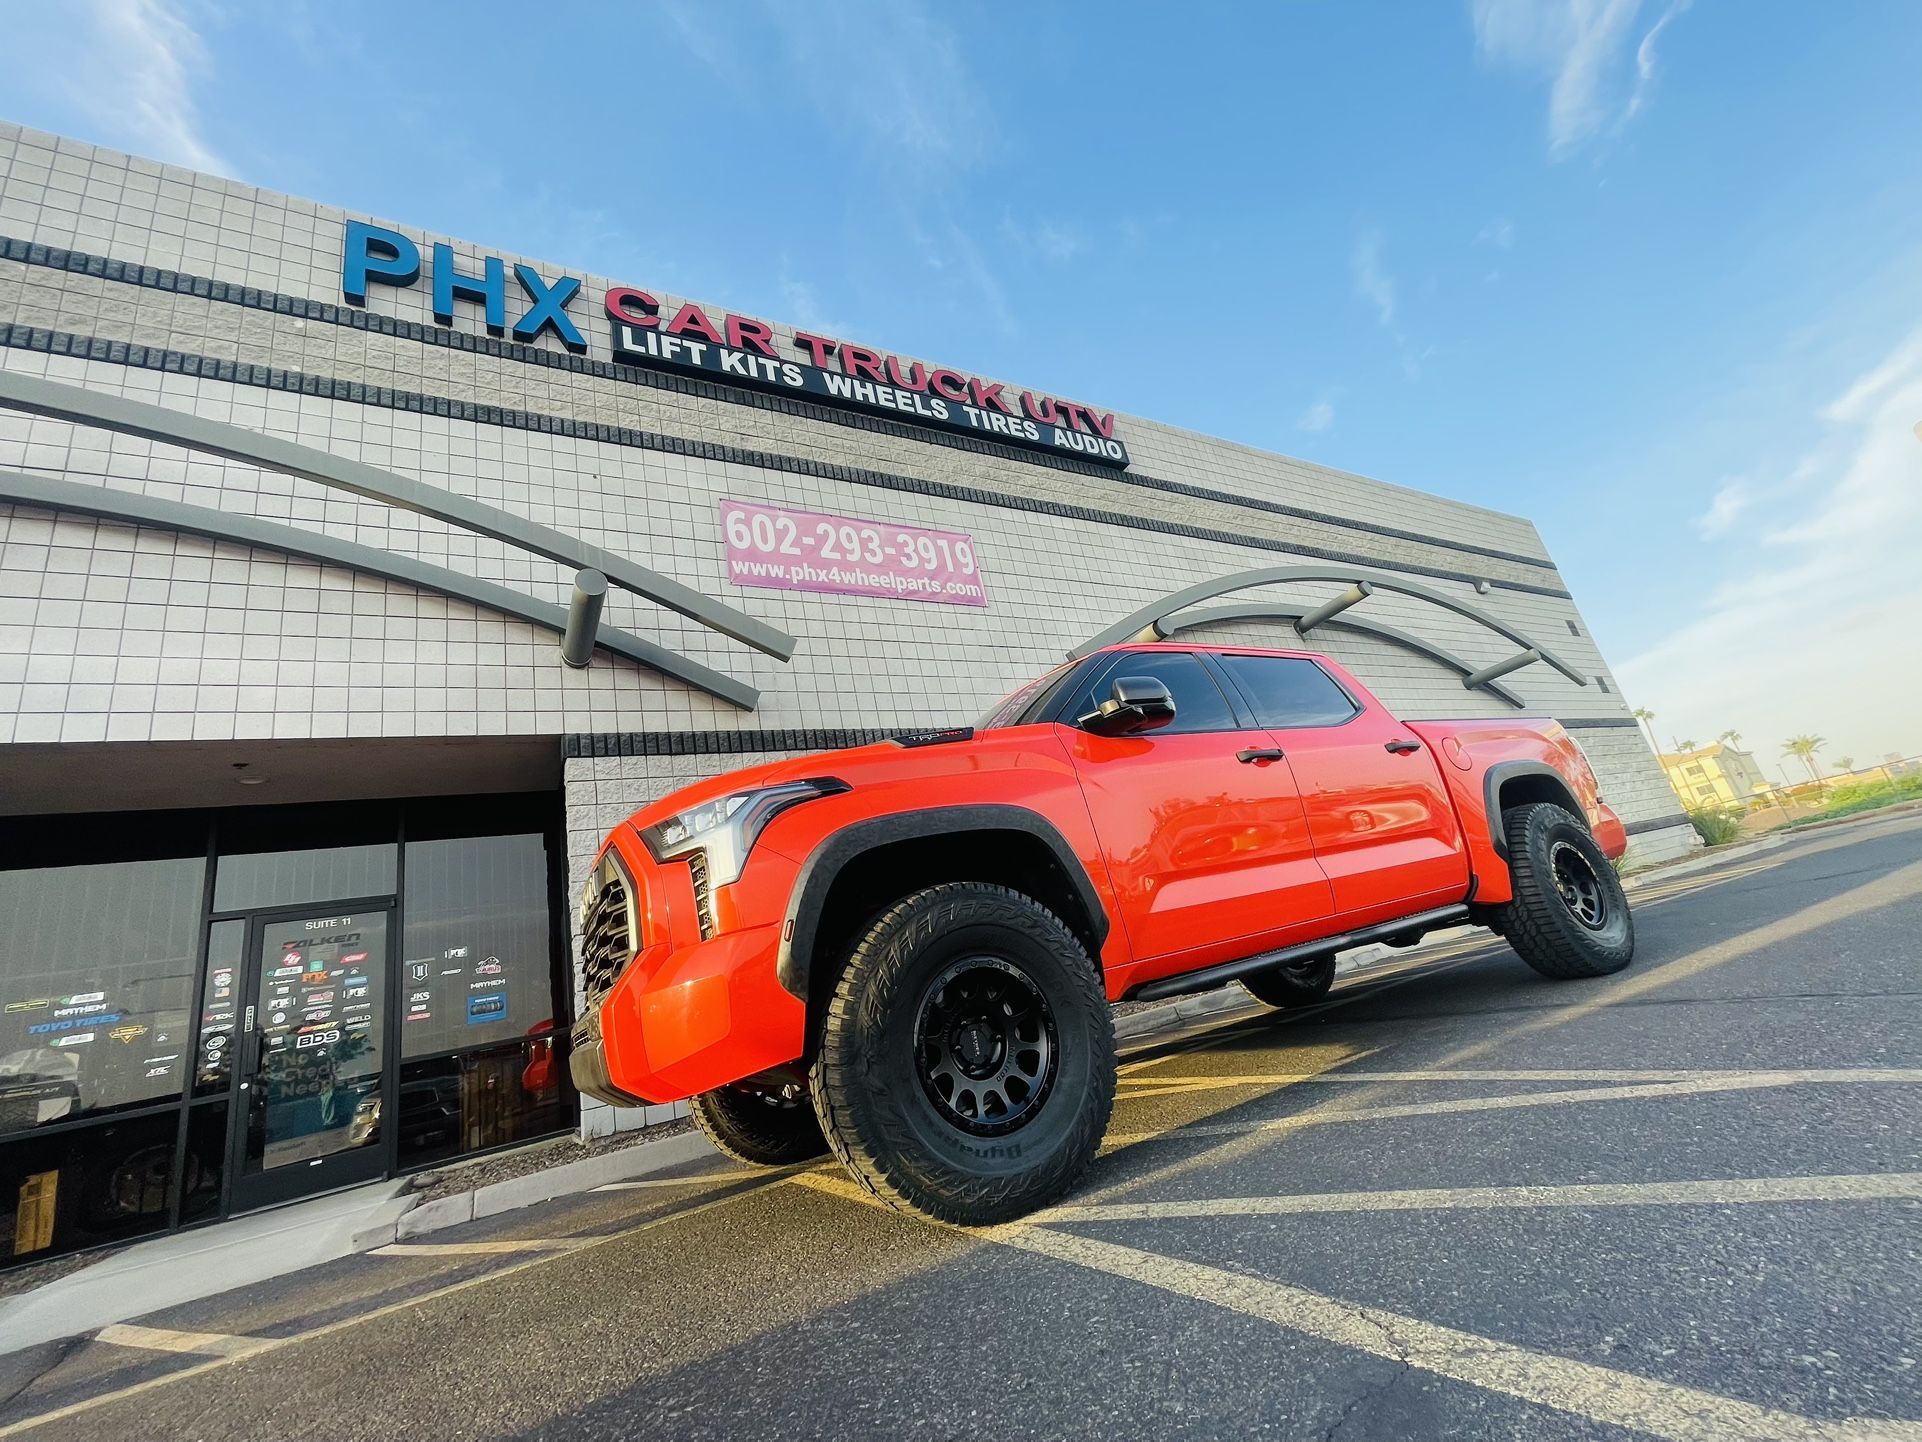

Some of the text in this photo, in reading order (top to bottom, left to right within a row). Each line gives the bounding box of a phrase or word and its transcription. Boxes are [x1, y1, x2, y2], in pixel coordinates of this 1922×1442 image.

[343, 219, 587, 355] PHX
[604, 286, 1115, 438] CAR TRUCK UTV
[621, 325, 1123, 460] LIFT KITS WHEELS TIRES AUDIO
[725, 510, 976, 575] 602-293-3919
[731, 558, 982, 597] www.phx4wheelparts.com
[305, 917, 351, 930] SUITE 11
[53, 1003, 107, 1018] MAYHEM
[410, 991, 430, 1002] JKS
[28, 1013, 122, 1035] TOYO TIRES
[298, 1031, 340, 1047] BDS
